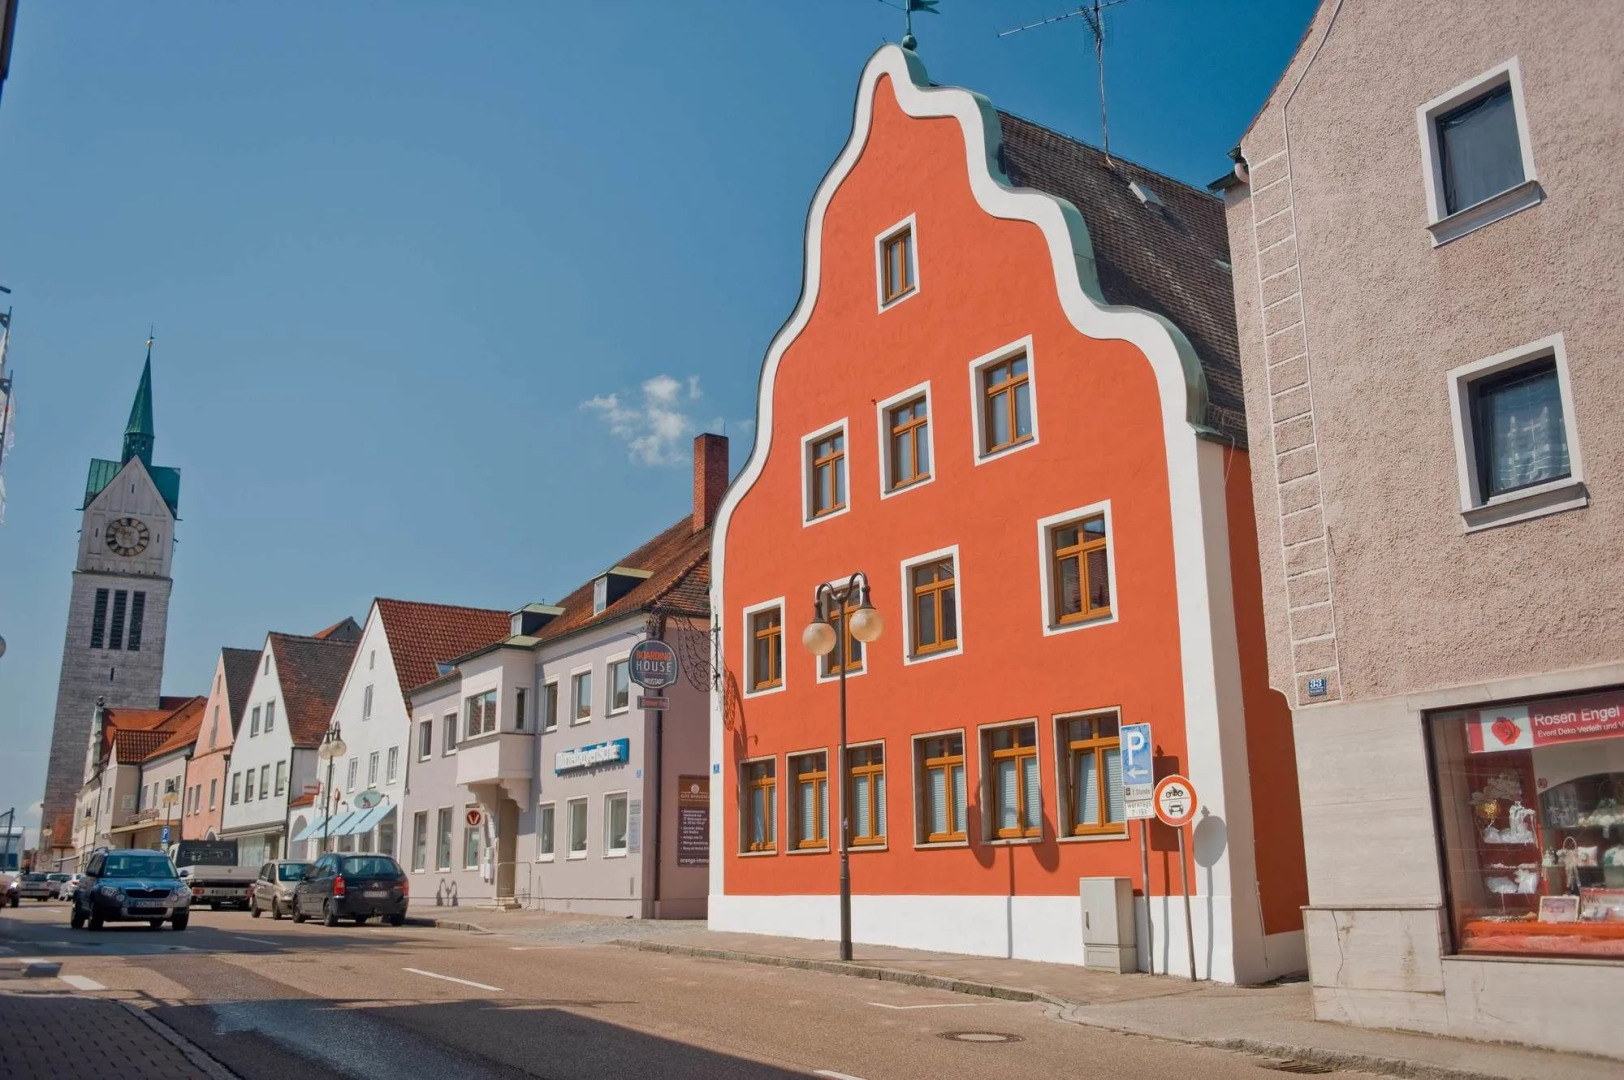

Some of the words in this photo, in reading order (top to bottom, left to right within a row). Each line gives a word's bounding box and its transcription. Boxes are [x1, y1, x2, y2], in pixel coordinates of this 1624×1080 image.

[636, 660, 672, 673] HOUSE
[1534, 712, 1577, 727] Rosen
[1581, 705, 1620, 722] Engel
[1537, 729, 1557, 738] Event
[1558, 726, 1576, 736] Deko
[1577, 724, 1602, 733] Verleih
[1603, 721, 1617, 730] und
[1128, 731, 1144, 765] P
